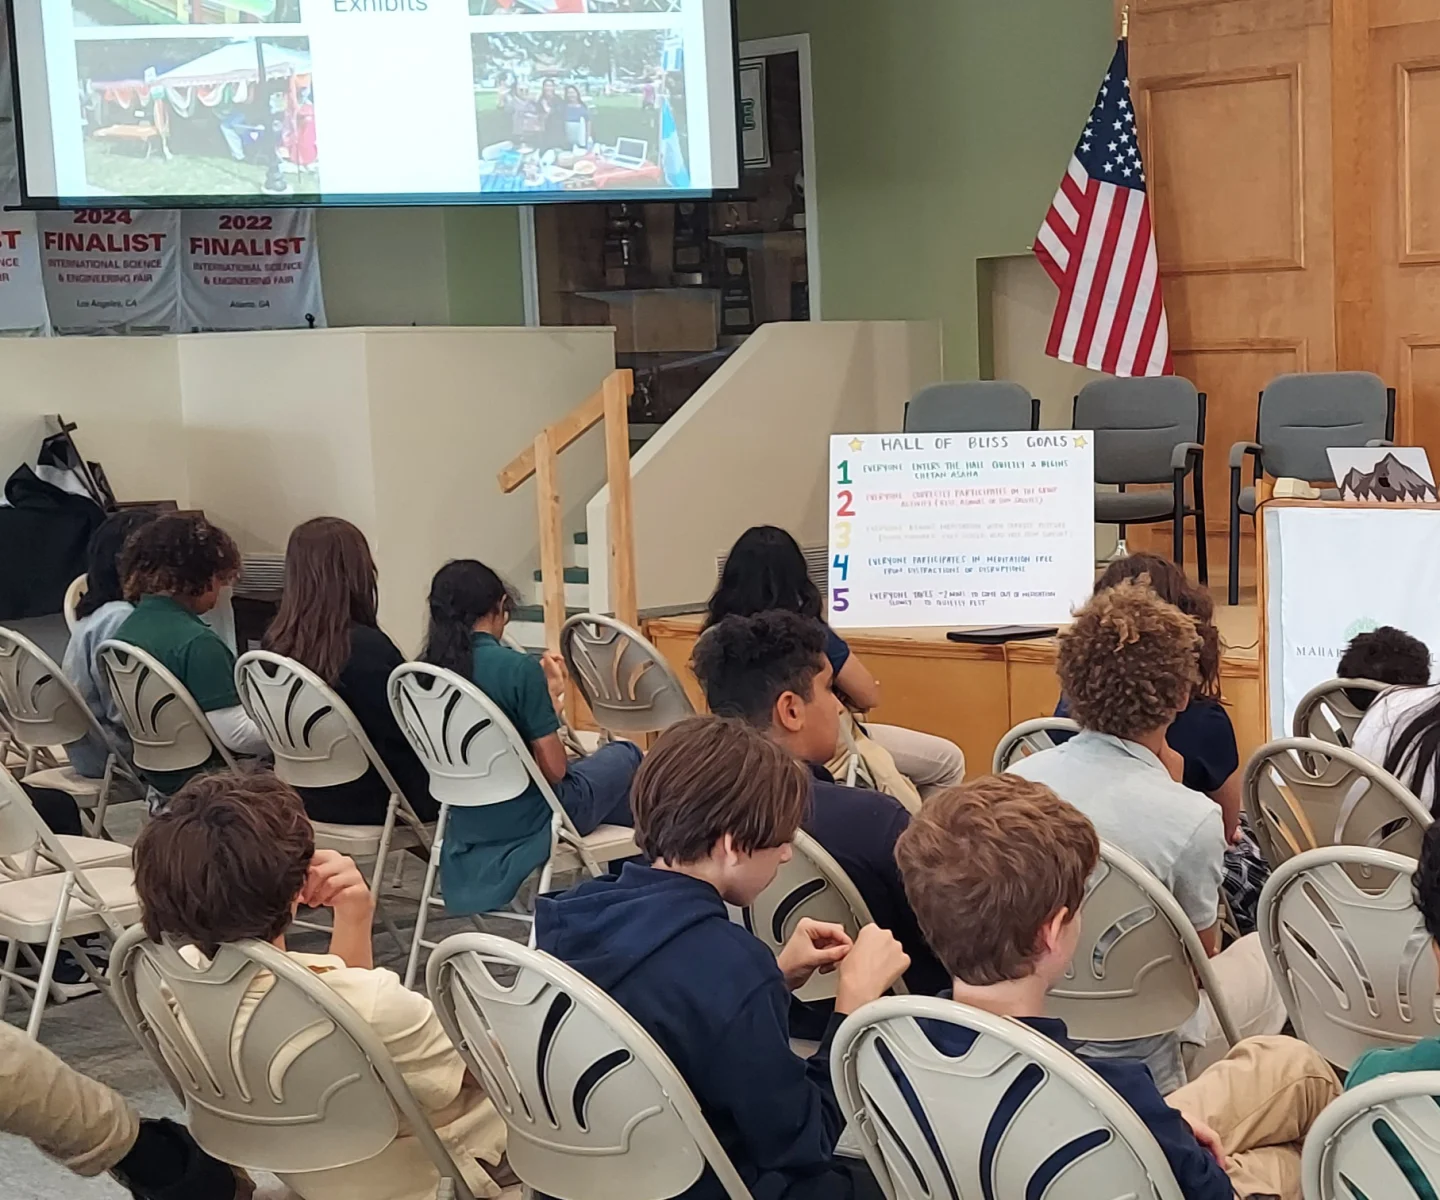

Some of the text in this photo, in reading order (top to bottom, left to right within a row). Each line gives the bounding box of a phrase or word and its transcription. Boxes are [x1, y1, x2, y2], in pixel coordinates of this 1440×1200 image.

[334, 0, 428, 12] Exhibits
[73, 209, 132, 224] 2024
[219, 215, 272, 230] 2022
[44, 231, 167, 252] FINALIST
[189, 237, 306, 256] FINALIST
[48, 258, 162, 269] INTERNATIONAL SCIENCE
[193, 261, 302, 272] INTERNATIONAL SCIENCE
[67, 273, 130, 284] ENGINEERING
[132, 273, 153, 283] FAIR
[213, 276, 271, 286] ENGINEERING
[274, 275, 294, 285] FAIR
[76, 299, 89, 307] Los
[125, 299, 137, 307] CA
[881, 435, 1067, 451] HALL OF BLISS GOALS
[837, 460, 852, 485] 1
[863, 463, 903, 473] EVERYONE
[912, 461, 940, 471] ENTERS
[944, 461, 960, 470] THE
[966, 460, 984, 470] HALL
[992, 460, 1025, 469] QUIETLY
[1041, 459, 1068, 468] BEGINS
[836, 490, 856, 517] 2
[834, 521, 850, 549] 3
[832, 554, 1053, 581] 4 EVERYONE PARTICIPATES IN MEDITATION FREE
[908, 566, 960, 574] DISTRACTIONS
[832, 588, 850, 612] 5
[869, 591, 908, 601] EVERYONE
